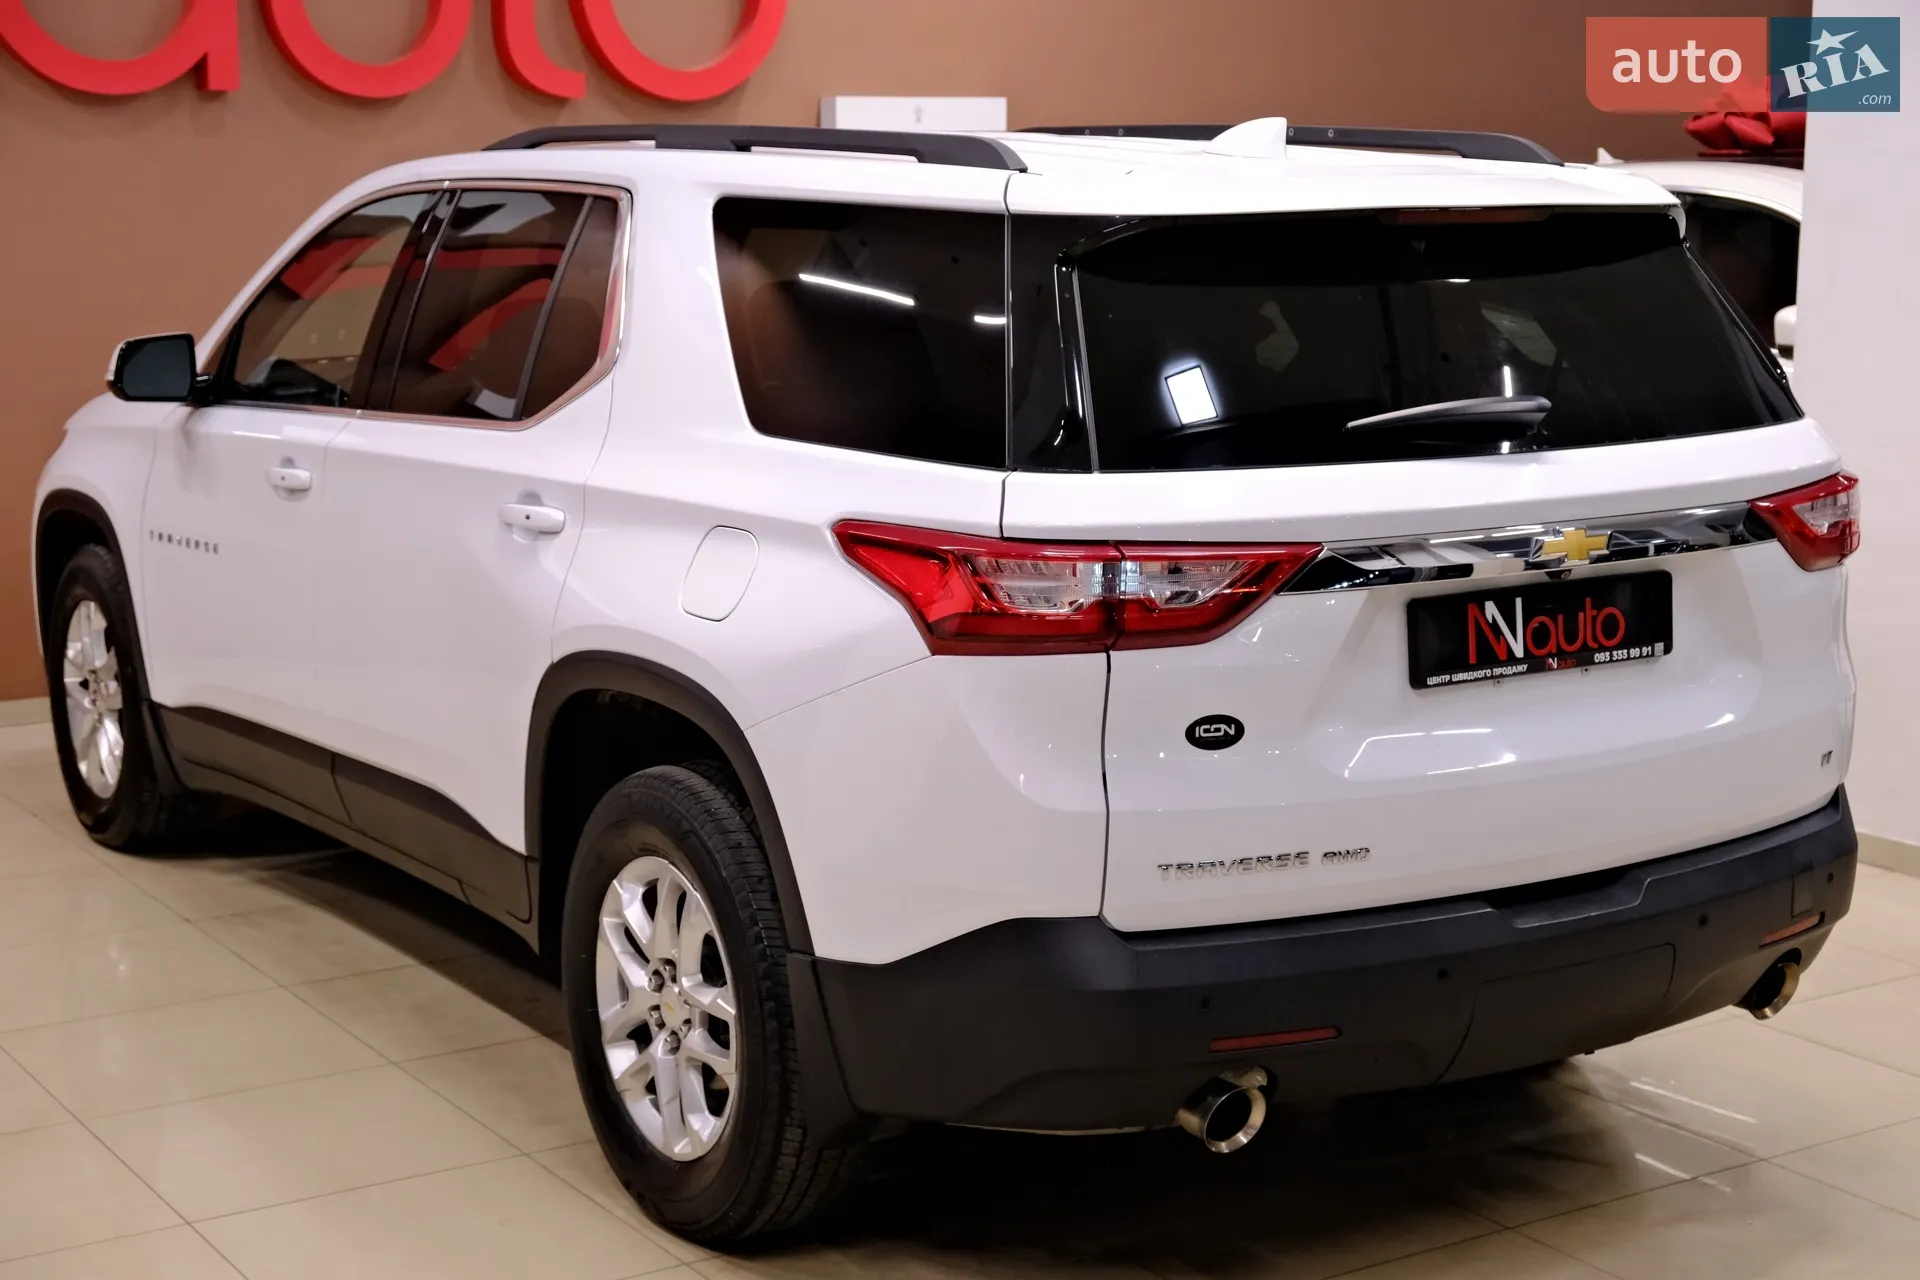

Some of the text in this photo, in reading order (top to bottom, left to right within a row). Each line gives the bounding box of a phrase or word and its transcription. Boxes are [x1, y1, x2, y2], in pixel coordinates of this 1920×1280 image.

[1594, 645, 1652, 663] 093 333 99 91
[1427, 664, 1528, 685] ЦЕНТР ШВИДКОГО ПРОДАЖУ
[1195, 723, 1236, 738] ICON
[1157, 847, 1371, 881] TRAVERSE AWD
